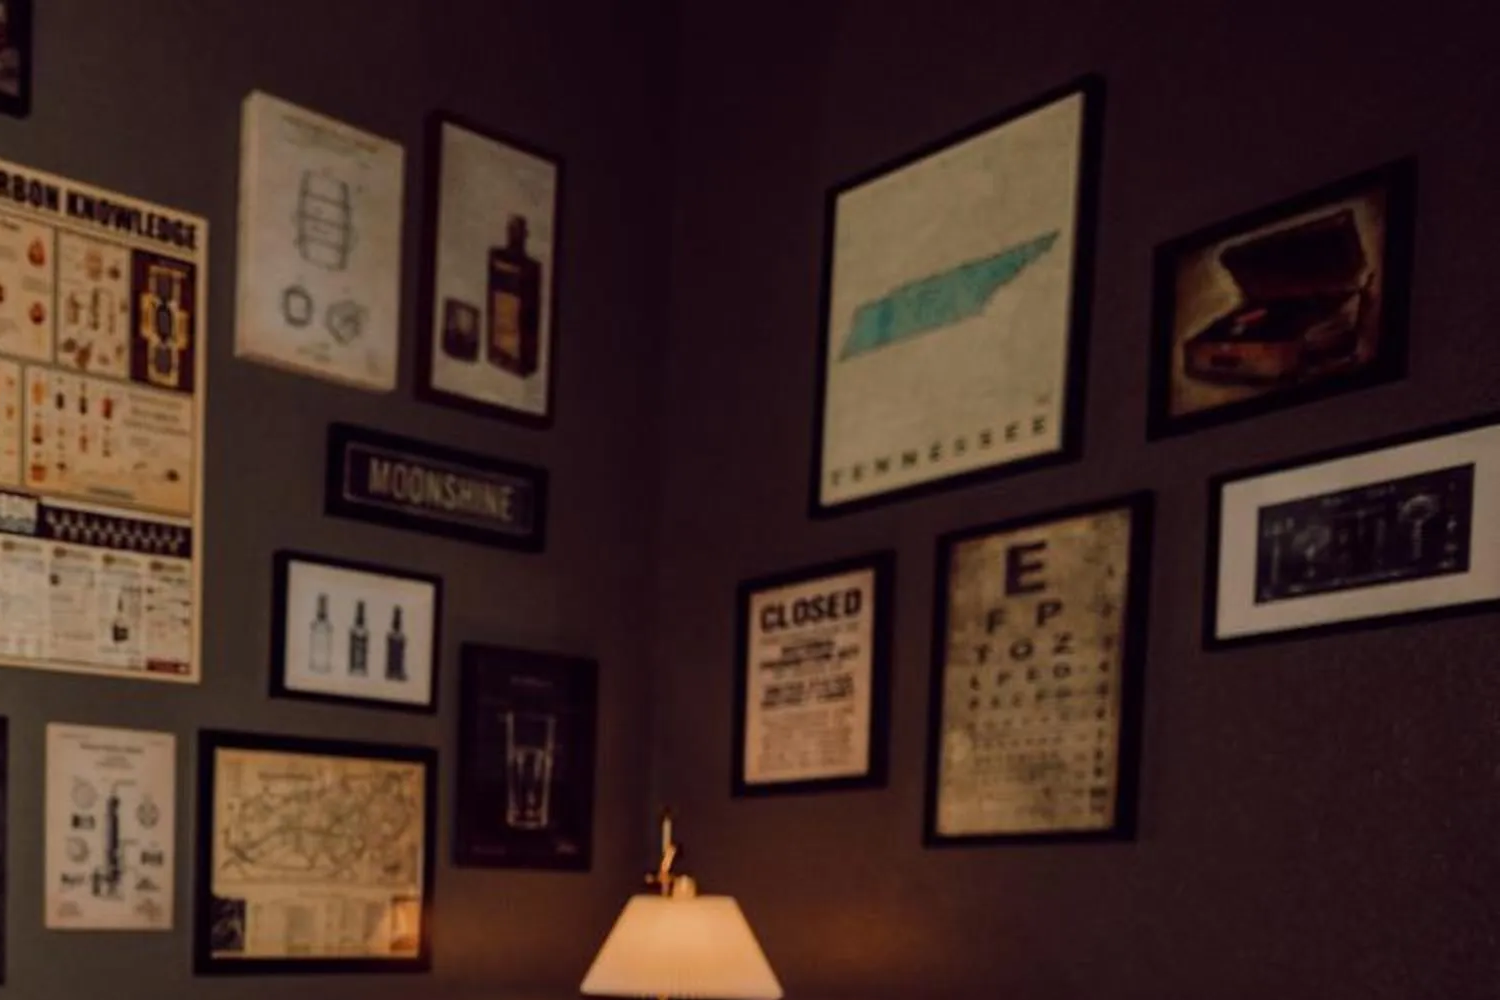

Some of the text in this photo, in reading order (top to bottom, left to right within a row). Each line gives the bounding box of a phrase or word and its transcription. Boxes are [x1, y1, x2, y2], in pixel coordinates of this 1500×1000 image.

[66, 190, 197, 249] KNOWLEDGE
[1004, 540, 1048, 596] E
[760, 588, 862, 633] CLOSED
